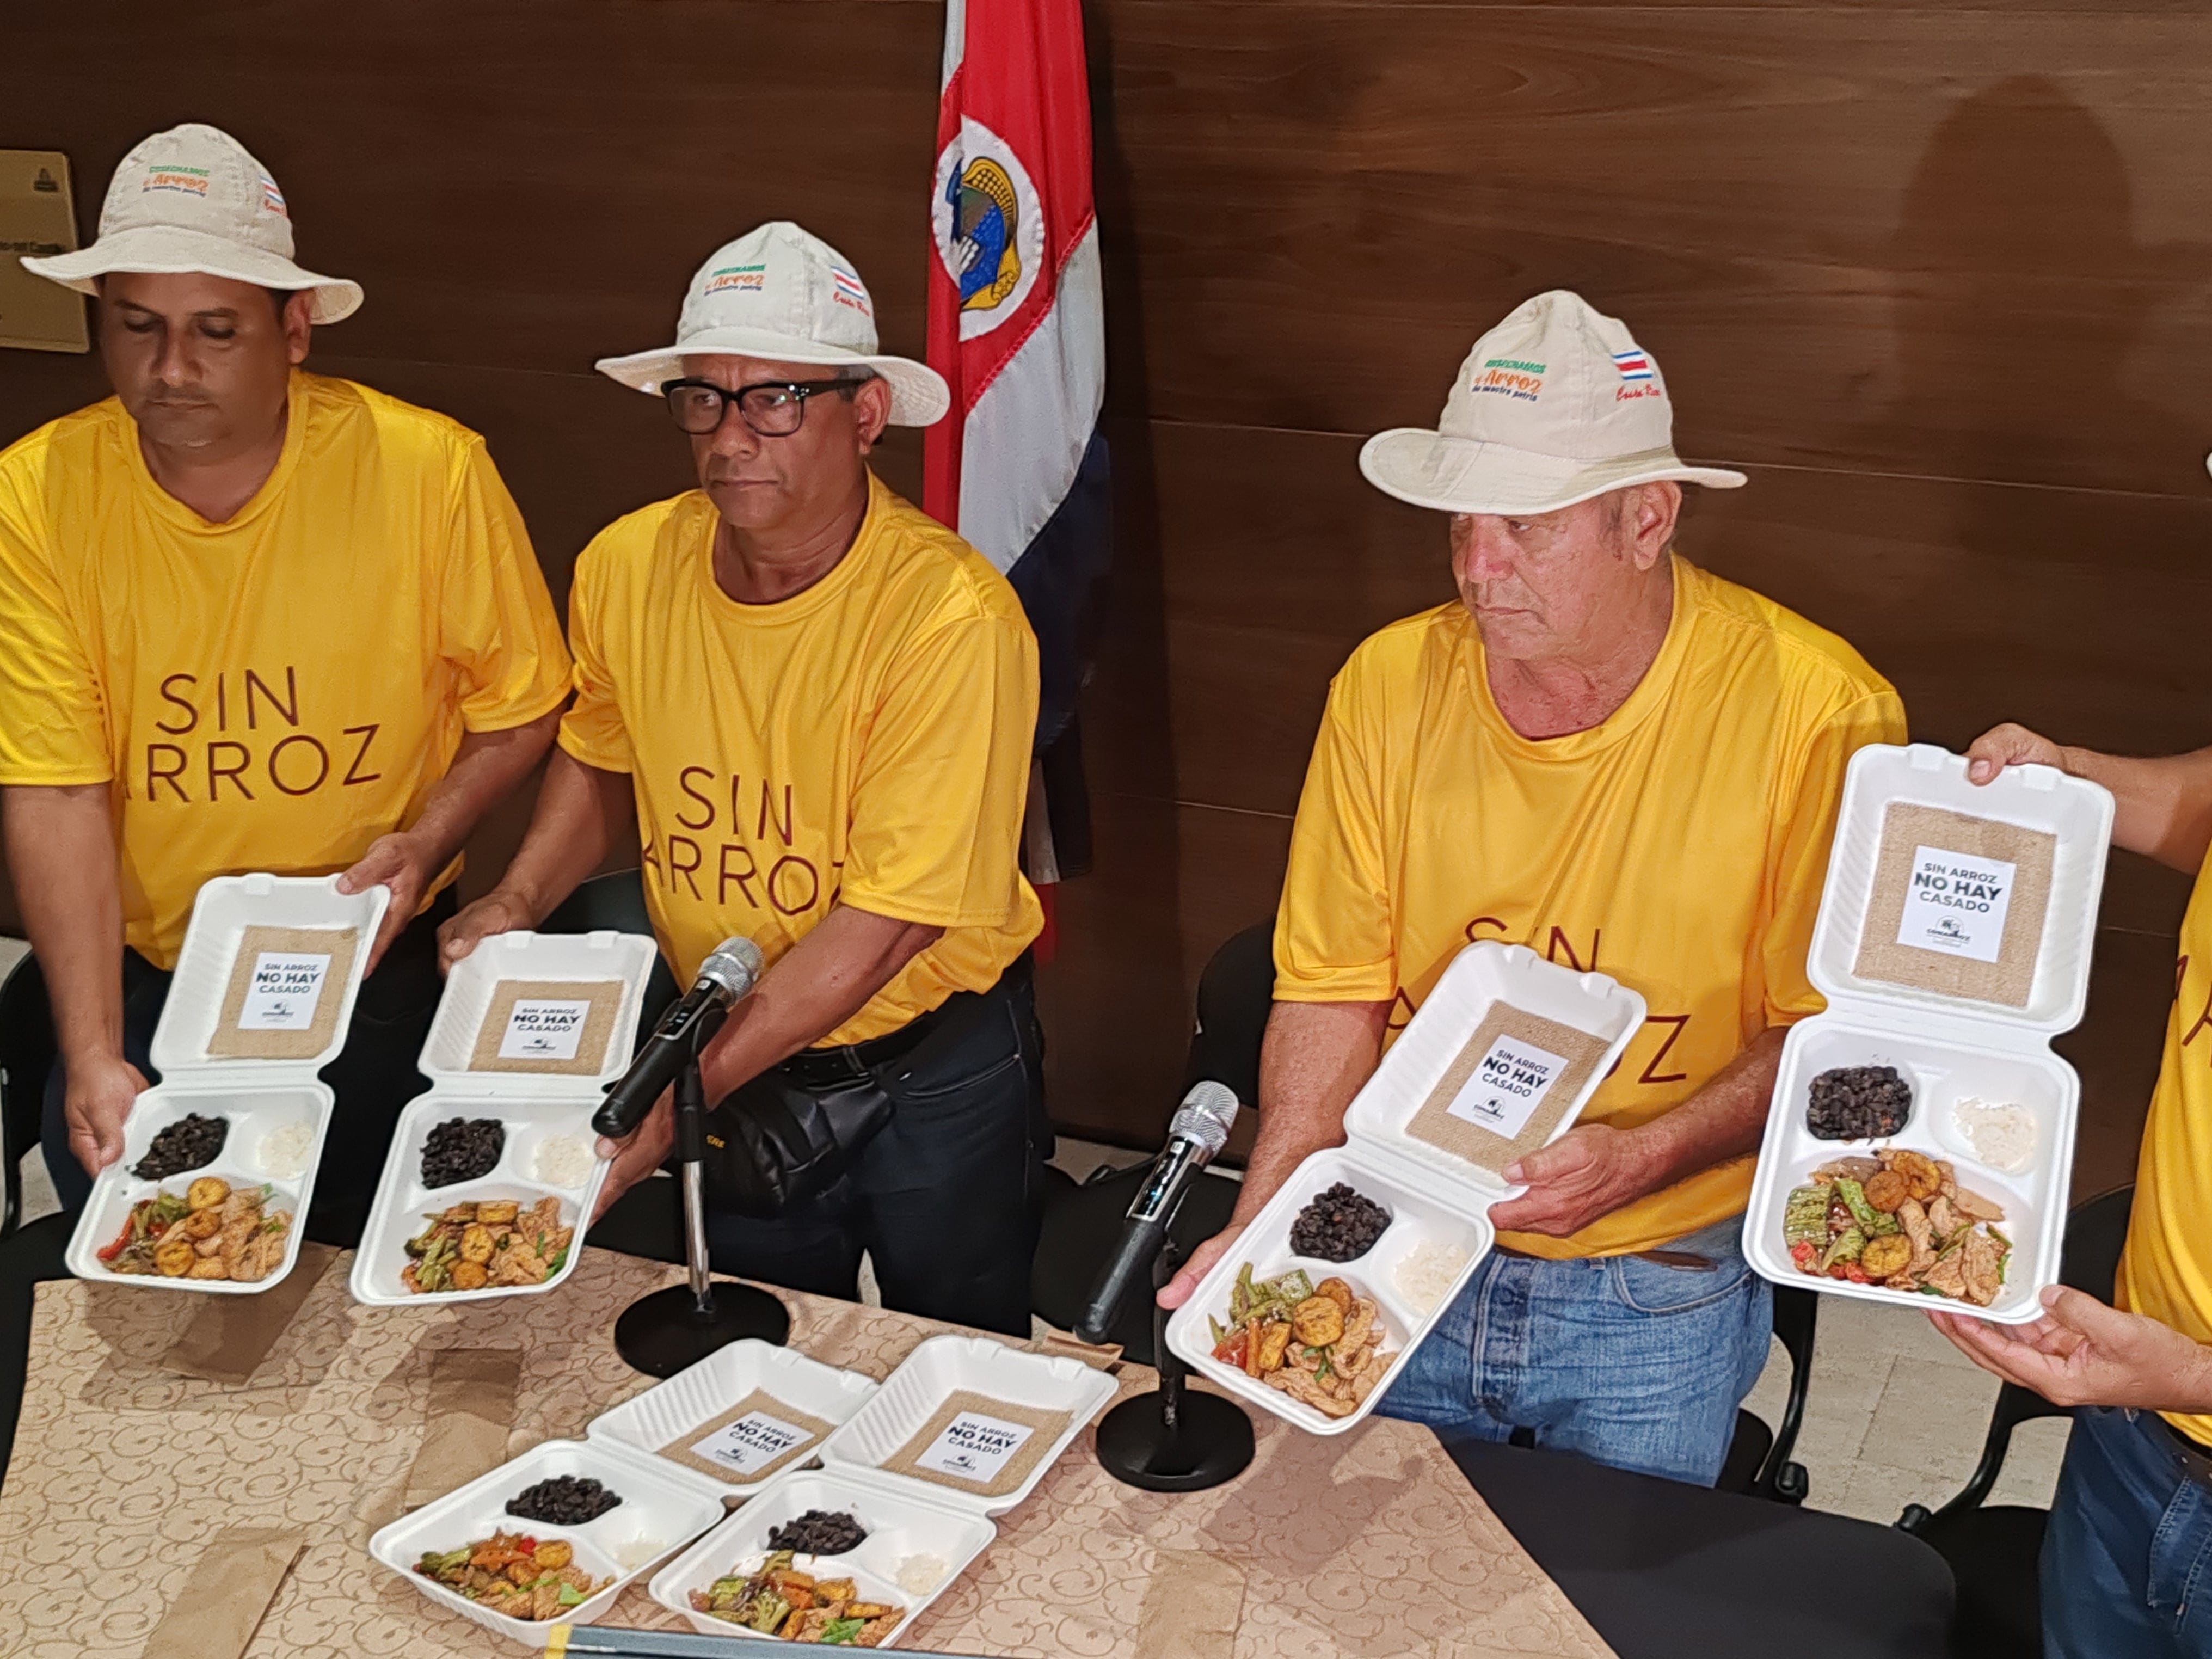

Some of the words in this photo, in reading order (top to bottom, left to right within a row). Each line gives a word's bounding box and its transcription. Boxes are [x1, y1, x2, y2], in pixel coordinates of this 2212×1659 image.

[156, 666, 299, 735] SIN
[126, 723, 382, 803] RROZ
[675, 766, 792, 846] SIN
[1924, 863, 1946, 874] SIN
[1949, 868, 1998, 884] ARROZ
[1914, 872, 1948, 890] NO
[1953, 881, 2002, 900] HAY
[1919, 891, 1990, 913] CASADO
[256, 972, 281, 983] NO
[285, 972, 321, 984] HAY
[259, 985, 311, 993] CASADO
[513, 1015, 540, 1023] NO
[544, 1015, 581, 1024] HAY
[517, 1024, 572, 1032] CASADO
[1483, 1056, 1510, 1074] NO
[1511, 1068, 1549, 1088] HAY
[1497, 1050, 1515, 1061] SIN
[1514, 1058, 1549, 1074] ARROZ
[1482, 1073, 1532, 1097] CASADO
[747, 1419, 764, 1428] SIN
[961, 1421, 979, 1430] SIN
[980, 1427, 1017, 1439] ARROZ
[729, 1431, 777, 1453] CASADO
[733, 1422, 758, 1435] NO
[758, 1431, 793, 1448] HAY
[948, 1426, 976, 1439] NO
[978, 1434, 1017, 1448] HAY
[948, 1437, 1002, 1454] CASADO
